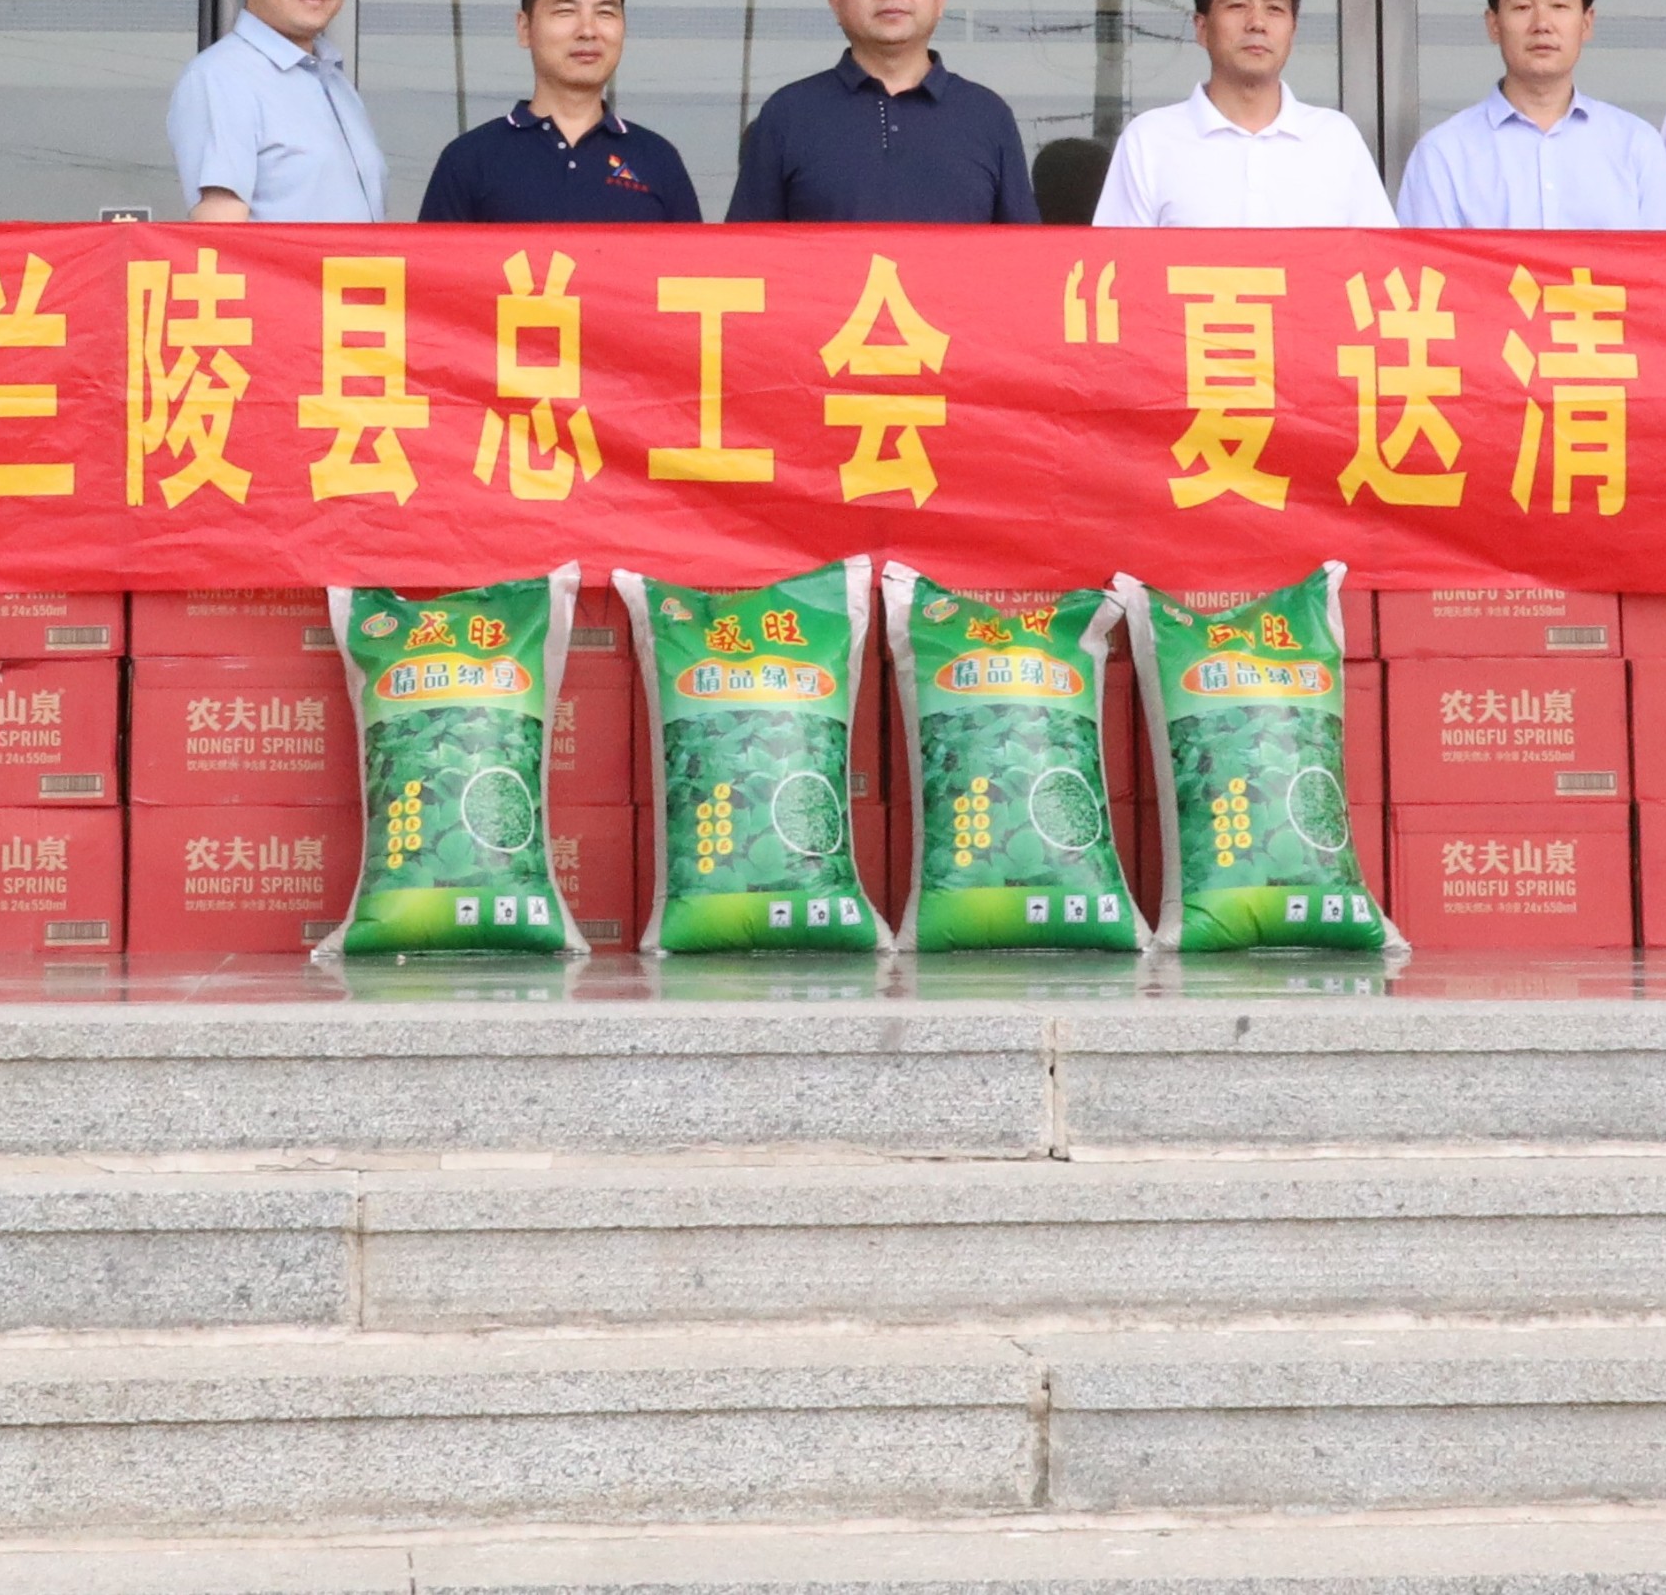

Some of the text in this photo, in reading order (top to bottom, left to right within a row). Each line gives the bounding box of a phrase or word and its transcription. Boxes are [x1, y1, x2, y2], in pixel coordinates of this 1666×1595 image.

[391, 662, 517, 696] 精品绿豆
[693, 665, 821, 695] 精品绿豆
[952, 658, 1072, 693] 精品绿豆
[1199, 661, 1321, 692] 精品绿豆
[184, 695, 326, 733] 农夫山泉
[1438, 688, 1577, 725] 农夫山泉
[1439, 727, 1576, 747] NONGFU SPRING
[183, 834, 325, 873] 农夫山泉
[1440, 838, 1579, 876] 农夫山泉
[3, 876, 68, 896] SPRING
[1441, 878, 1579, 898] NONGFU SPRING
